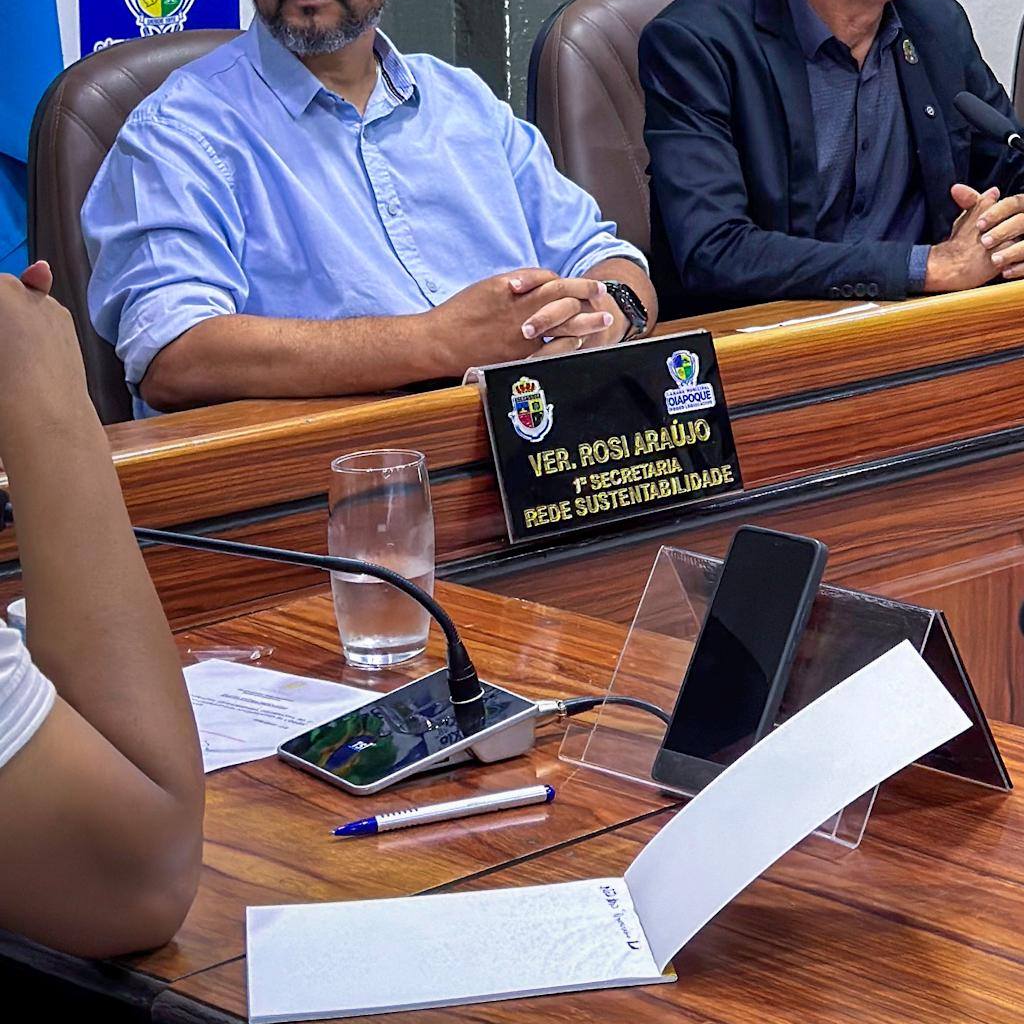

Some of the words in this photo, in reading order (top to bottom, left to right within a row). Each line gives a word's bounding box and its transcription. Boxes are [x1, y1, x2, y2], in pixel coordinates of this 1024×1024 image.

[668, 391, 712, 407] OIAPOQUE
[528, 448, 577, 478] VER.
[578, 435, 629, 467] ROSI
[633, 418, 711, 456] ARAÚJO
[523, 500, 573, 528] REDE
[574, 465, 735, 517] SUSTENTABILIDADE
[589, 457, 683, 491] SECRETARIA
